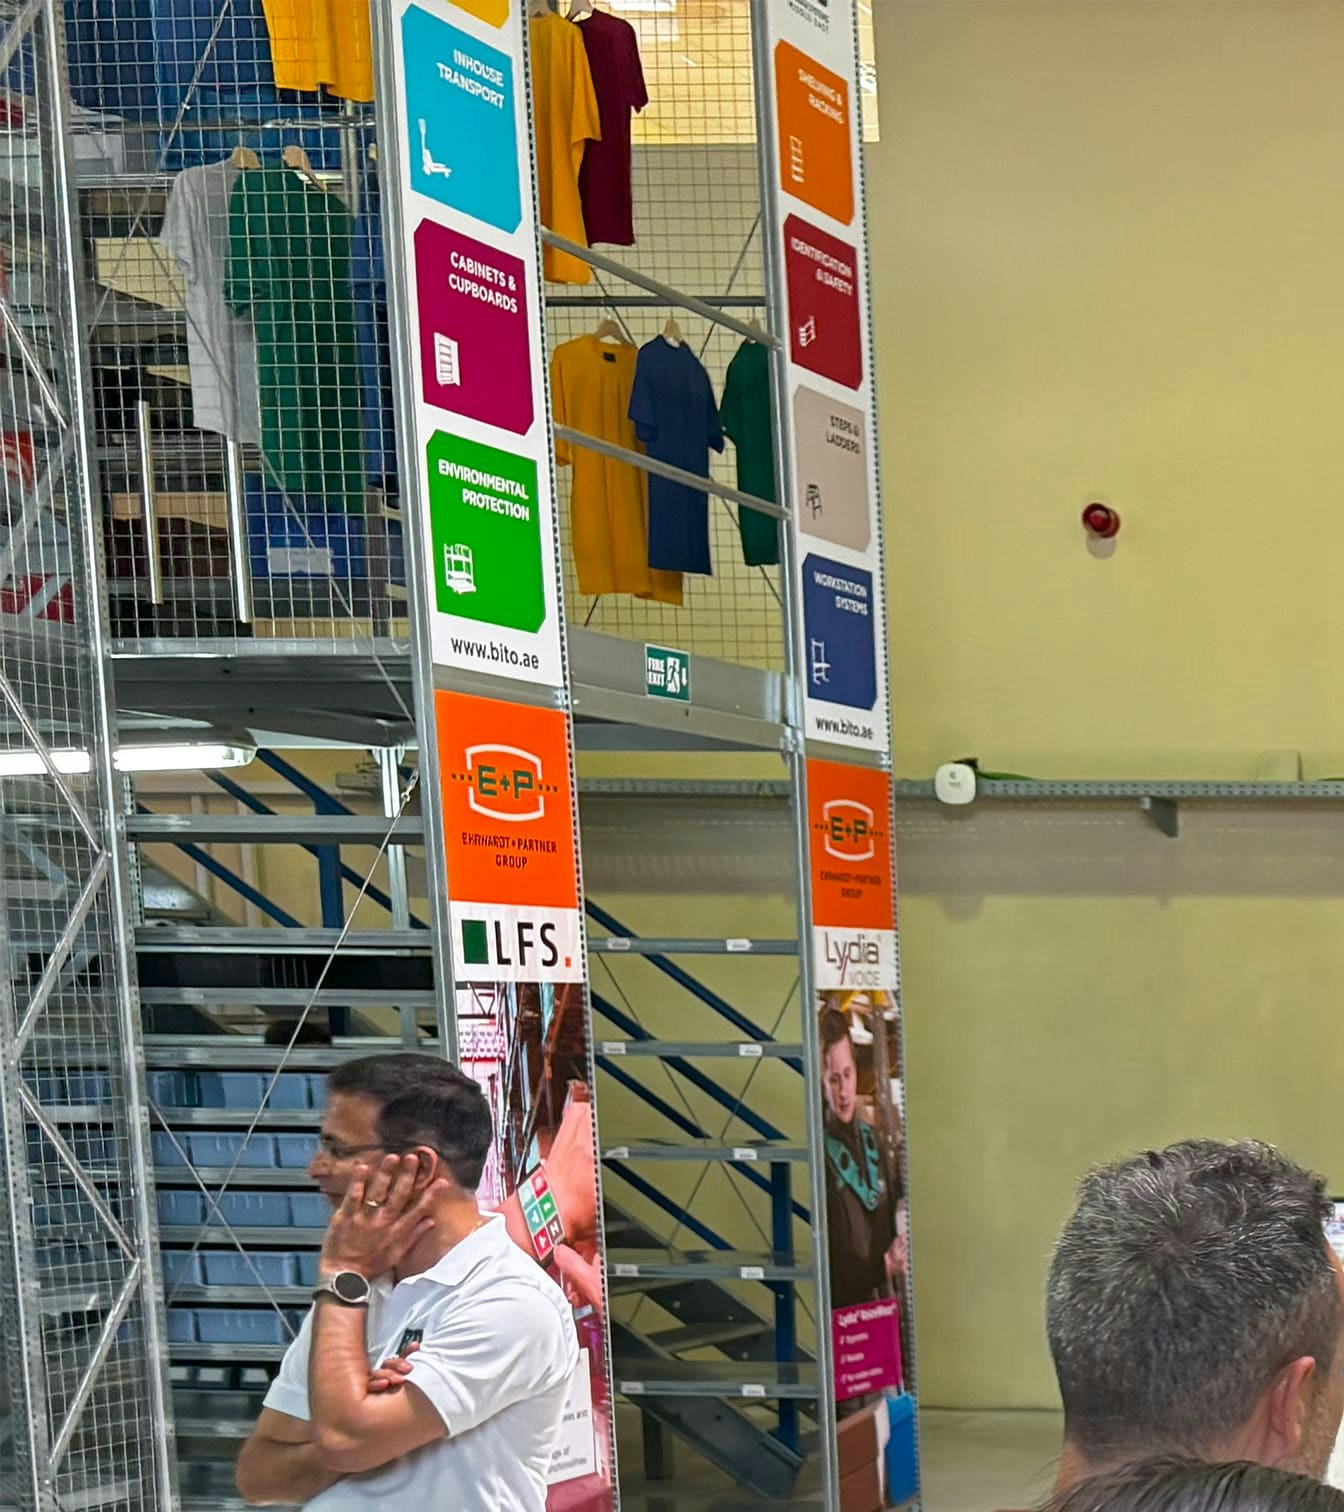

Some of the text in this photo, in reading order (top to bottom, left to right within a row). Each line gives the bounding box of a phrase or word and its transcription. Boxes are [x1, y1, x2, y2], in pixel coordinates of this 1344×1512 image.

[436, 62, 505, 110] TRANSPORT
[453, 48, 505, 88] INHOUSE
[450, 251, 517, 291] CABINETS &
[448, 273, 518, 314] CUPBOARDS
[438, 458, 530, 501] ENVIRONMENTAL
[462, 488, 531, 522] PROTECTION
[450, 636, 540, 670] www.bito.ae
[495, 854, 528, 870] GROUP
